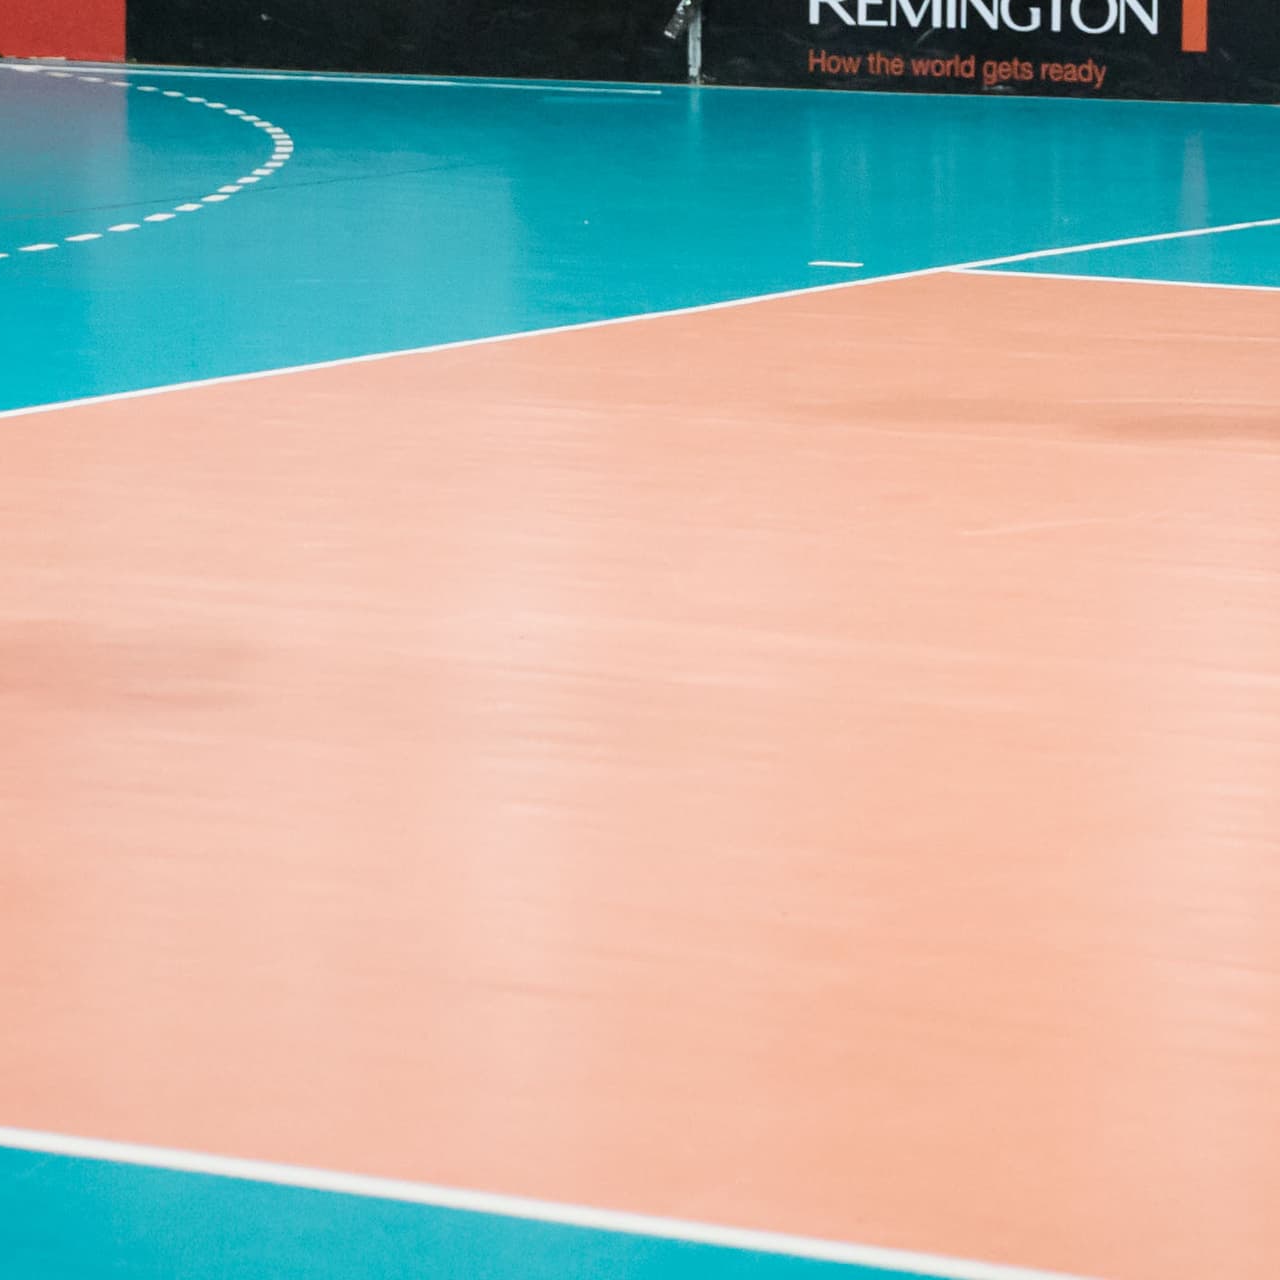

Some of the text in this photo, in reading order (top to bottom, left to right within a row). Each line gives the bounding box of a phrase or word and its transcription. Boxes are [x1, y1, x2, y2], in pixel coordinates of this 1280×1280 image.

[808, 49, 1107, 89] How the world gets ready
